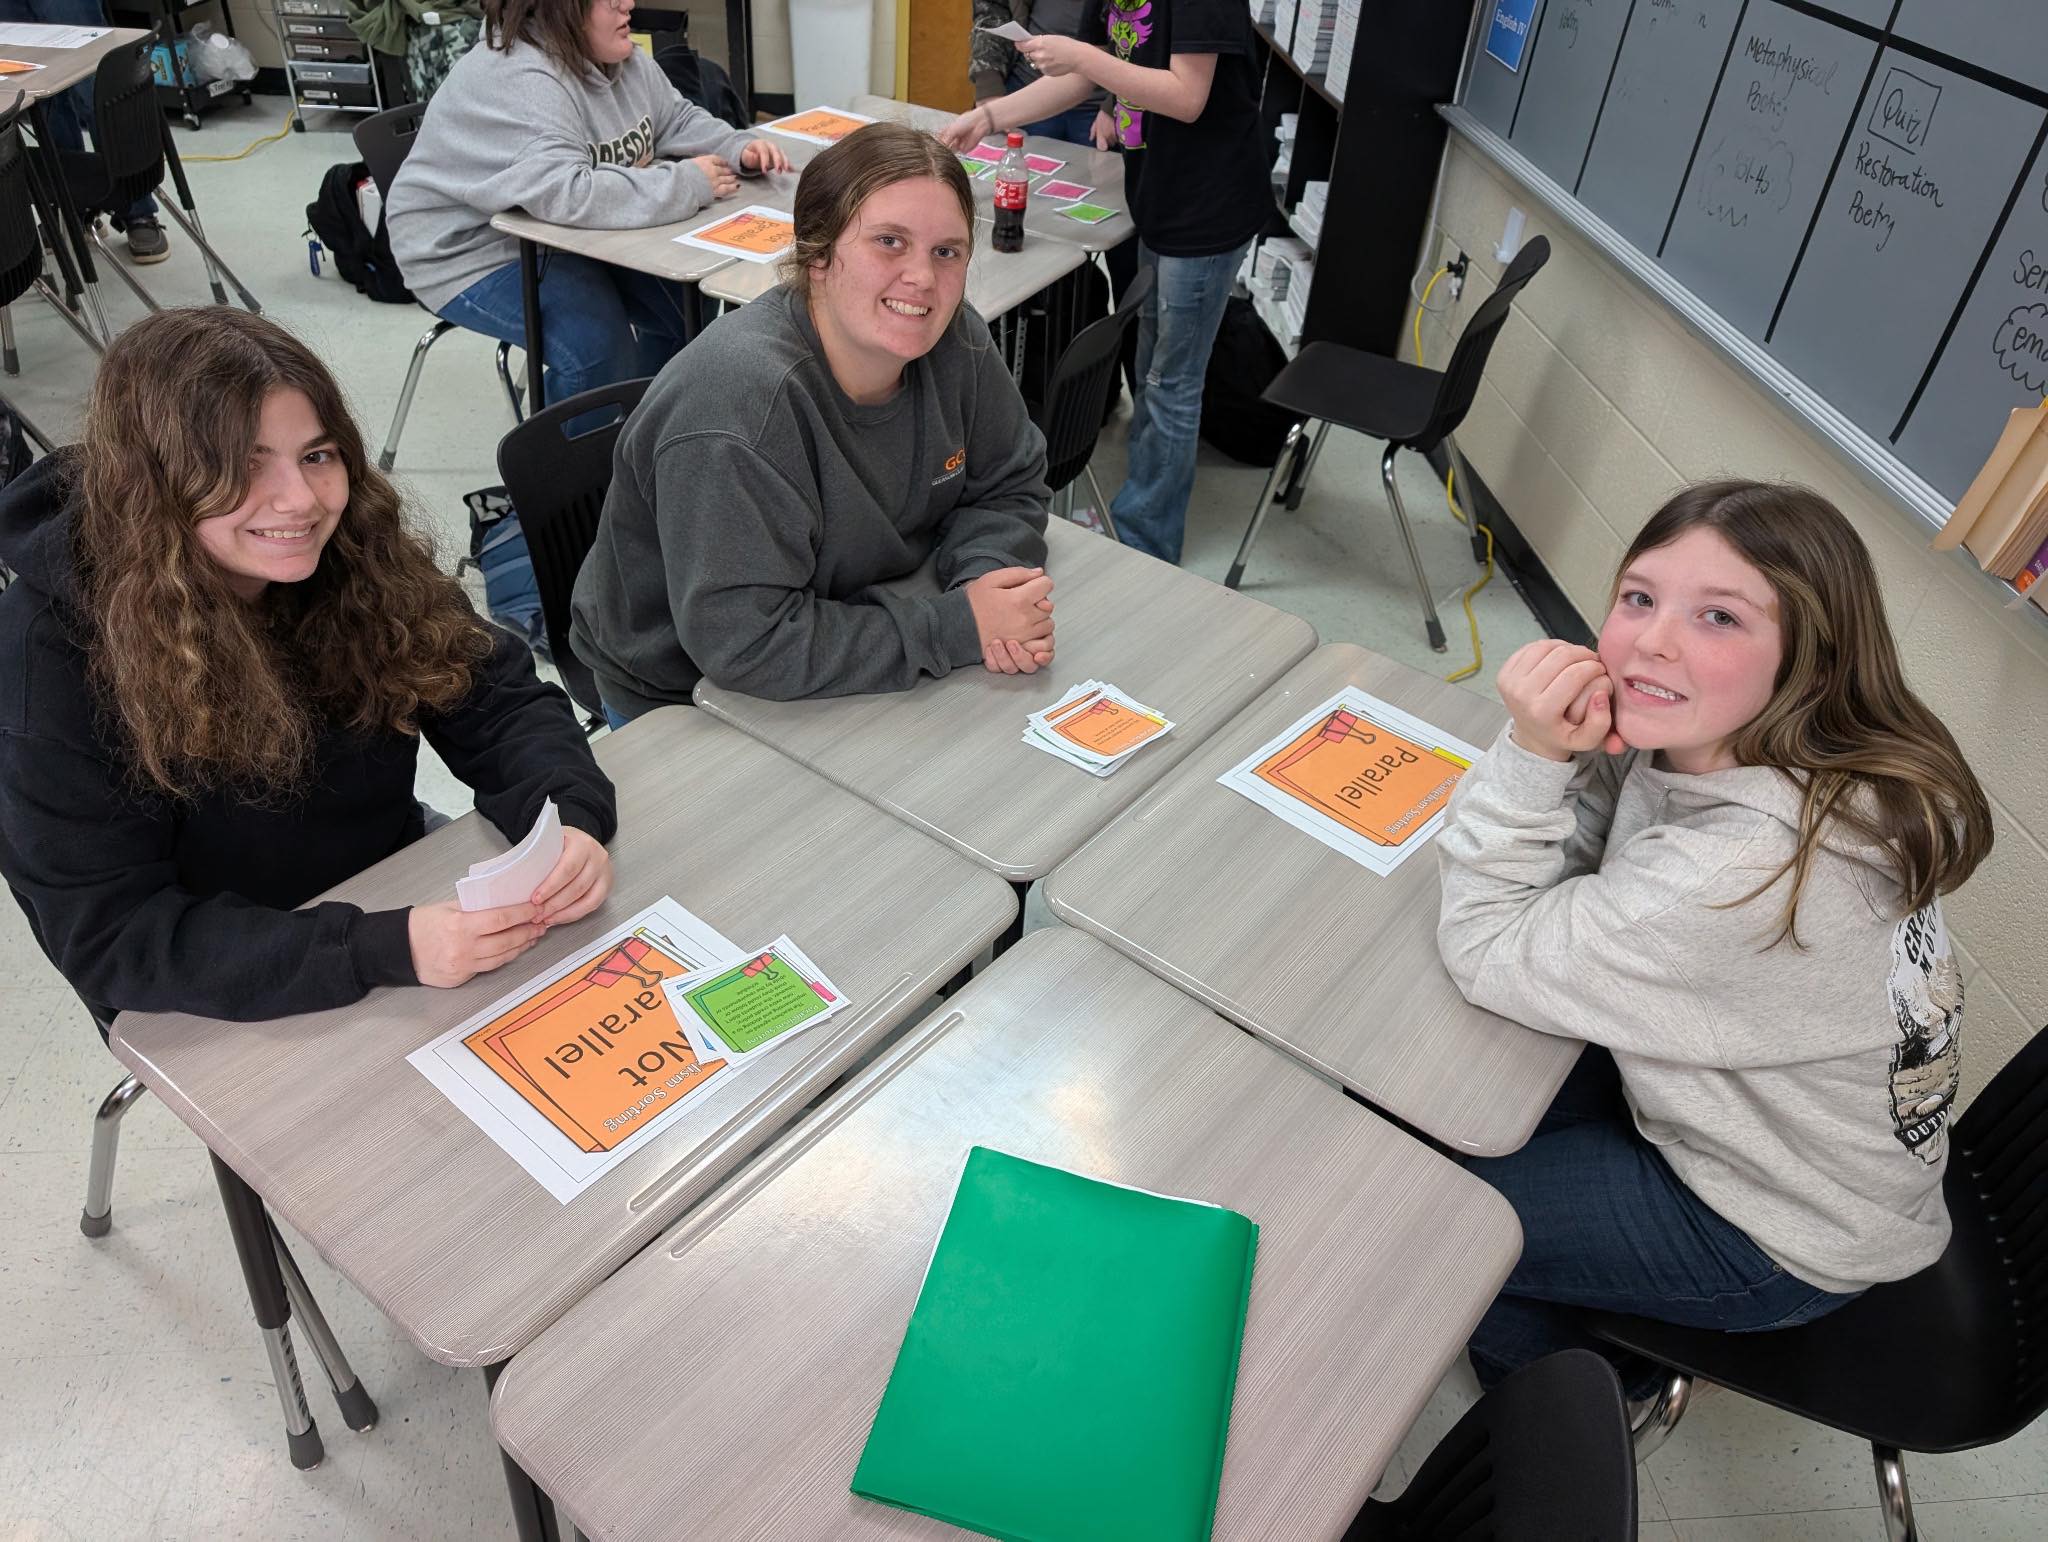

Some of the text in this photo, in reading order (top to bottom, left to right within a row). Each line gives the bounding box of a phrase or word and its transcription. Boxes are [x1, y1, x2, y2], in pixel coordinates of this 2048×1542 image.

[1495, 8, 1519, 32] English
[1883, 88, 1922, 145] Quiz
[1855, 140, 1944, 209] Restoration
[1849, 189, 1897, 253] Poetry
[1333, 745, 1419, 812] Parallel
[1384, 806, 1421, 836] Sorting
[542, 987, 663, 1080] arallel
[617, 1029, 696, 1092] Not
[603, 1085, 668, 1133] Sorting
